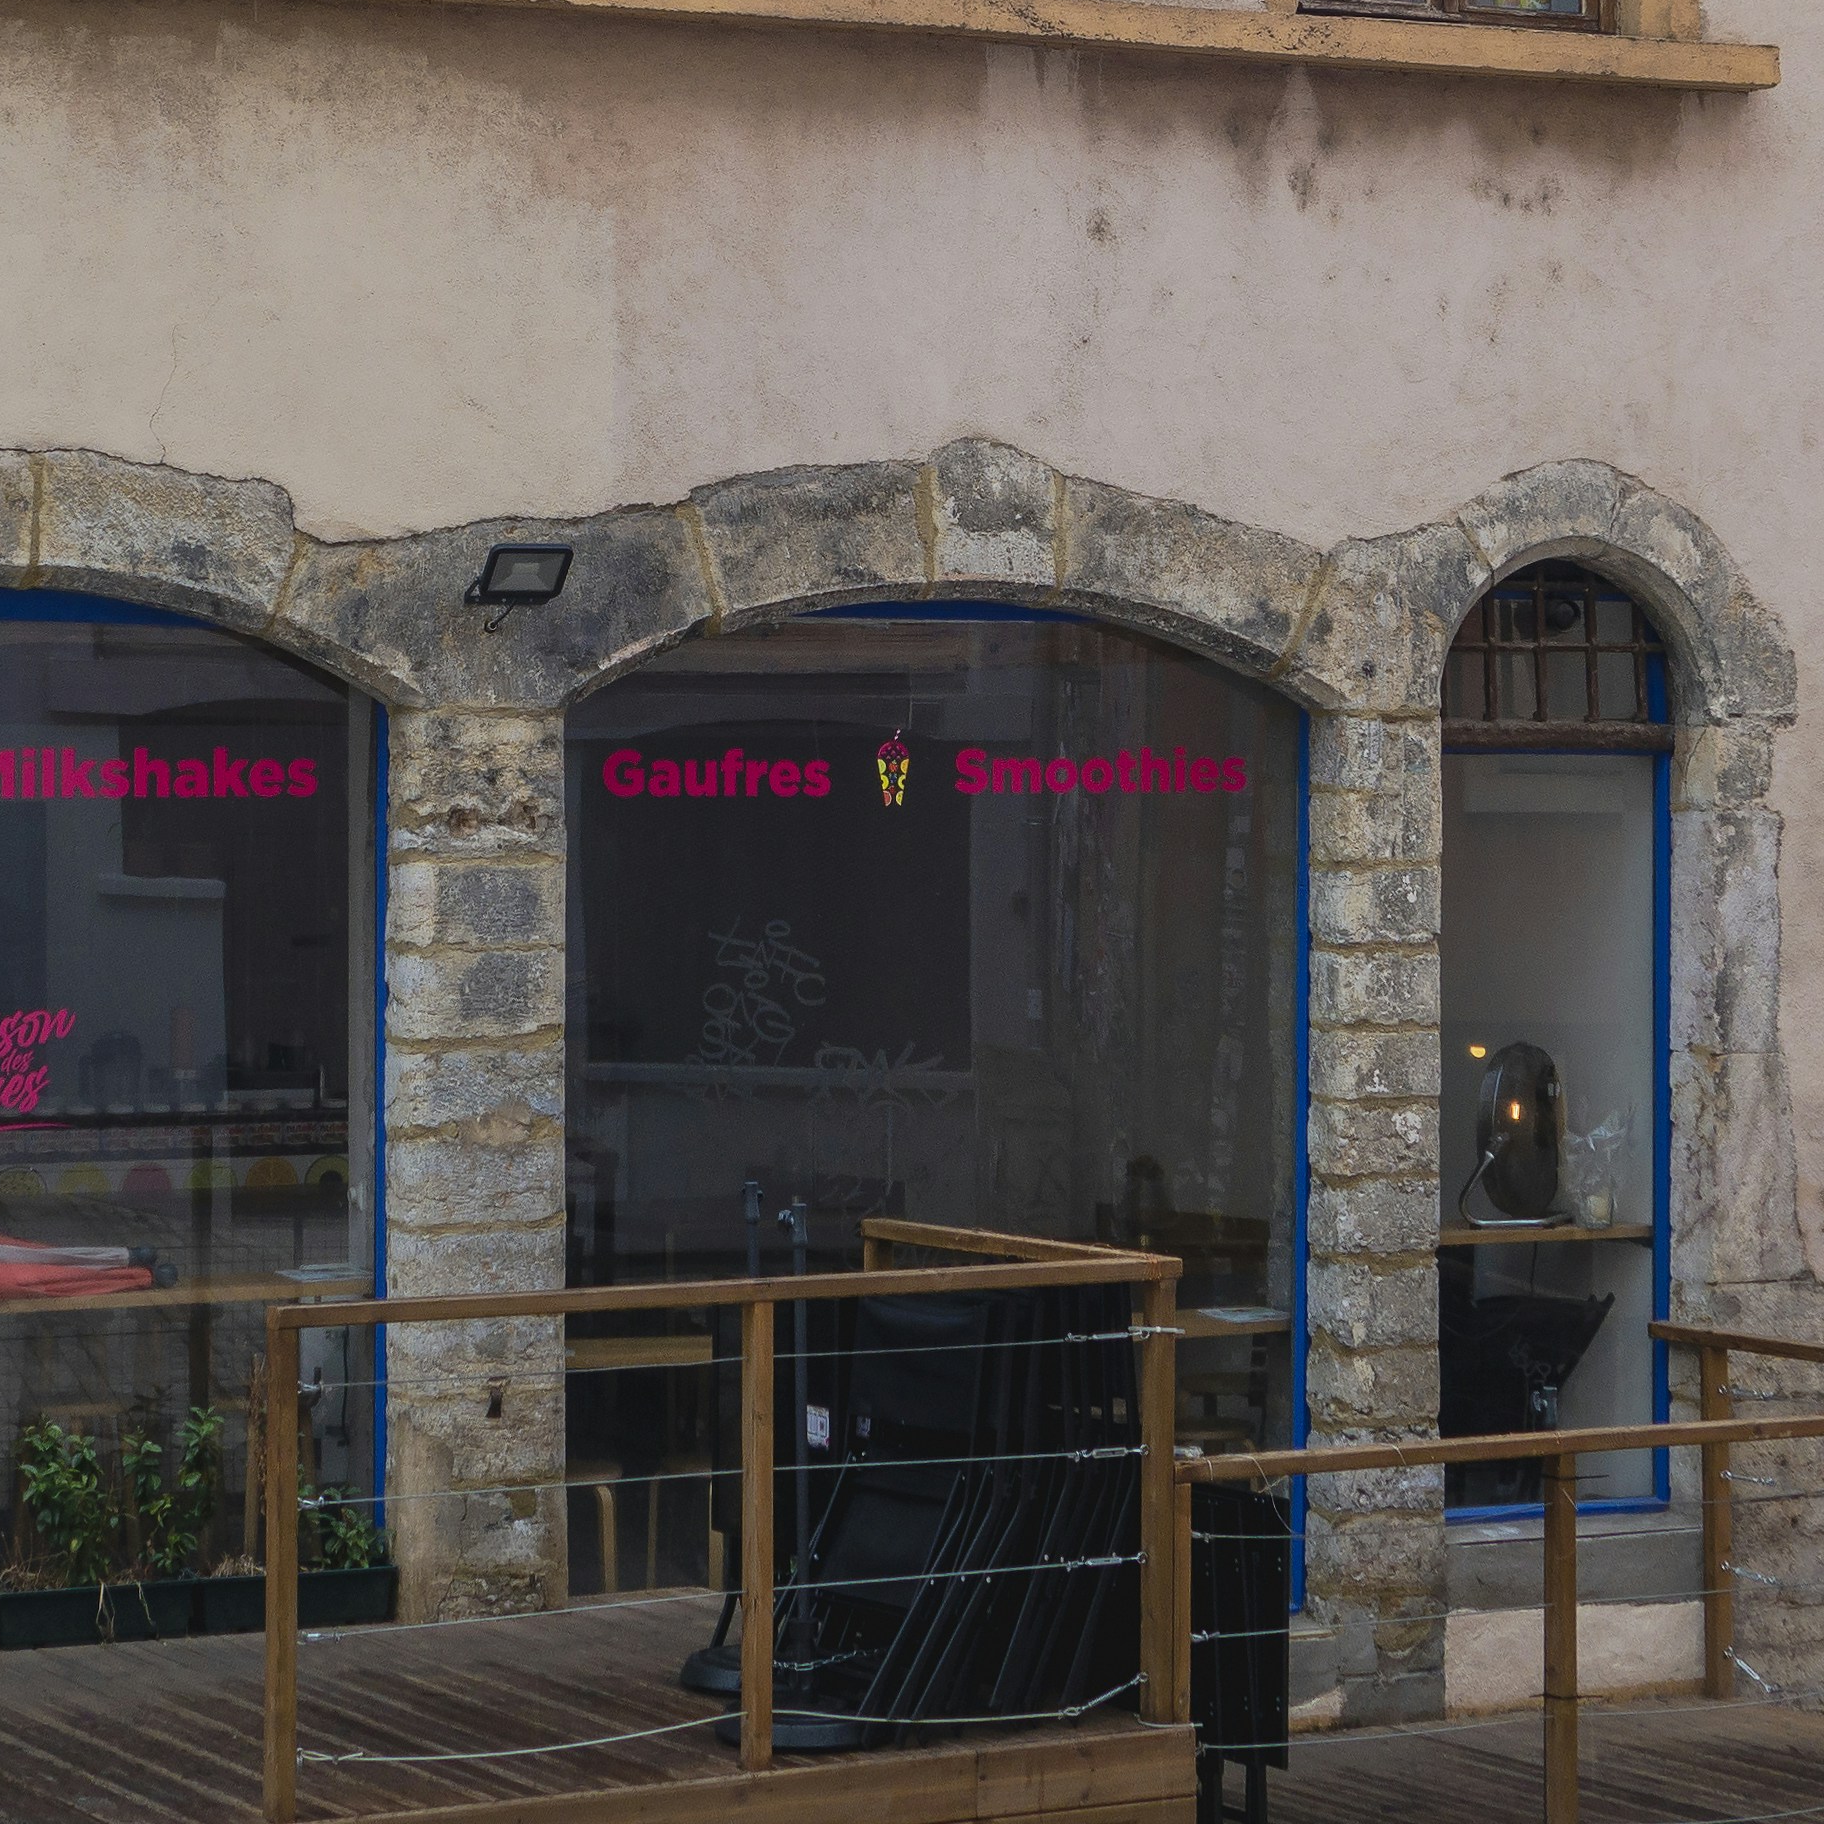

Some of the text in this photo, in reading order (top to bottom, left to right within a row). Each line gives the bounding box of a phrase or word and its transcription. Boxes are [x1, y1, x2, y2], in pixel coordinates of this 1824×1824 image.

[602, 747, 832, 798] Gaufres
[954, 746, 1248, 795] Smoothies
[0, 1049, 34, 1075] des
